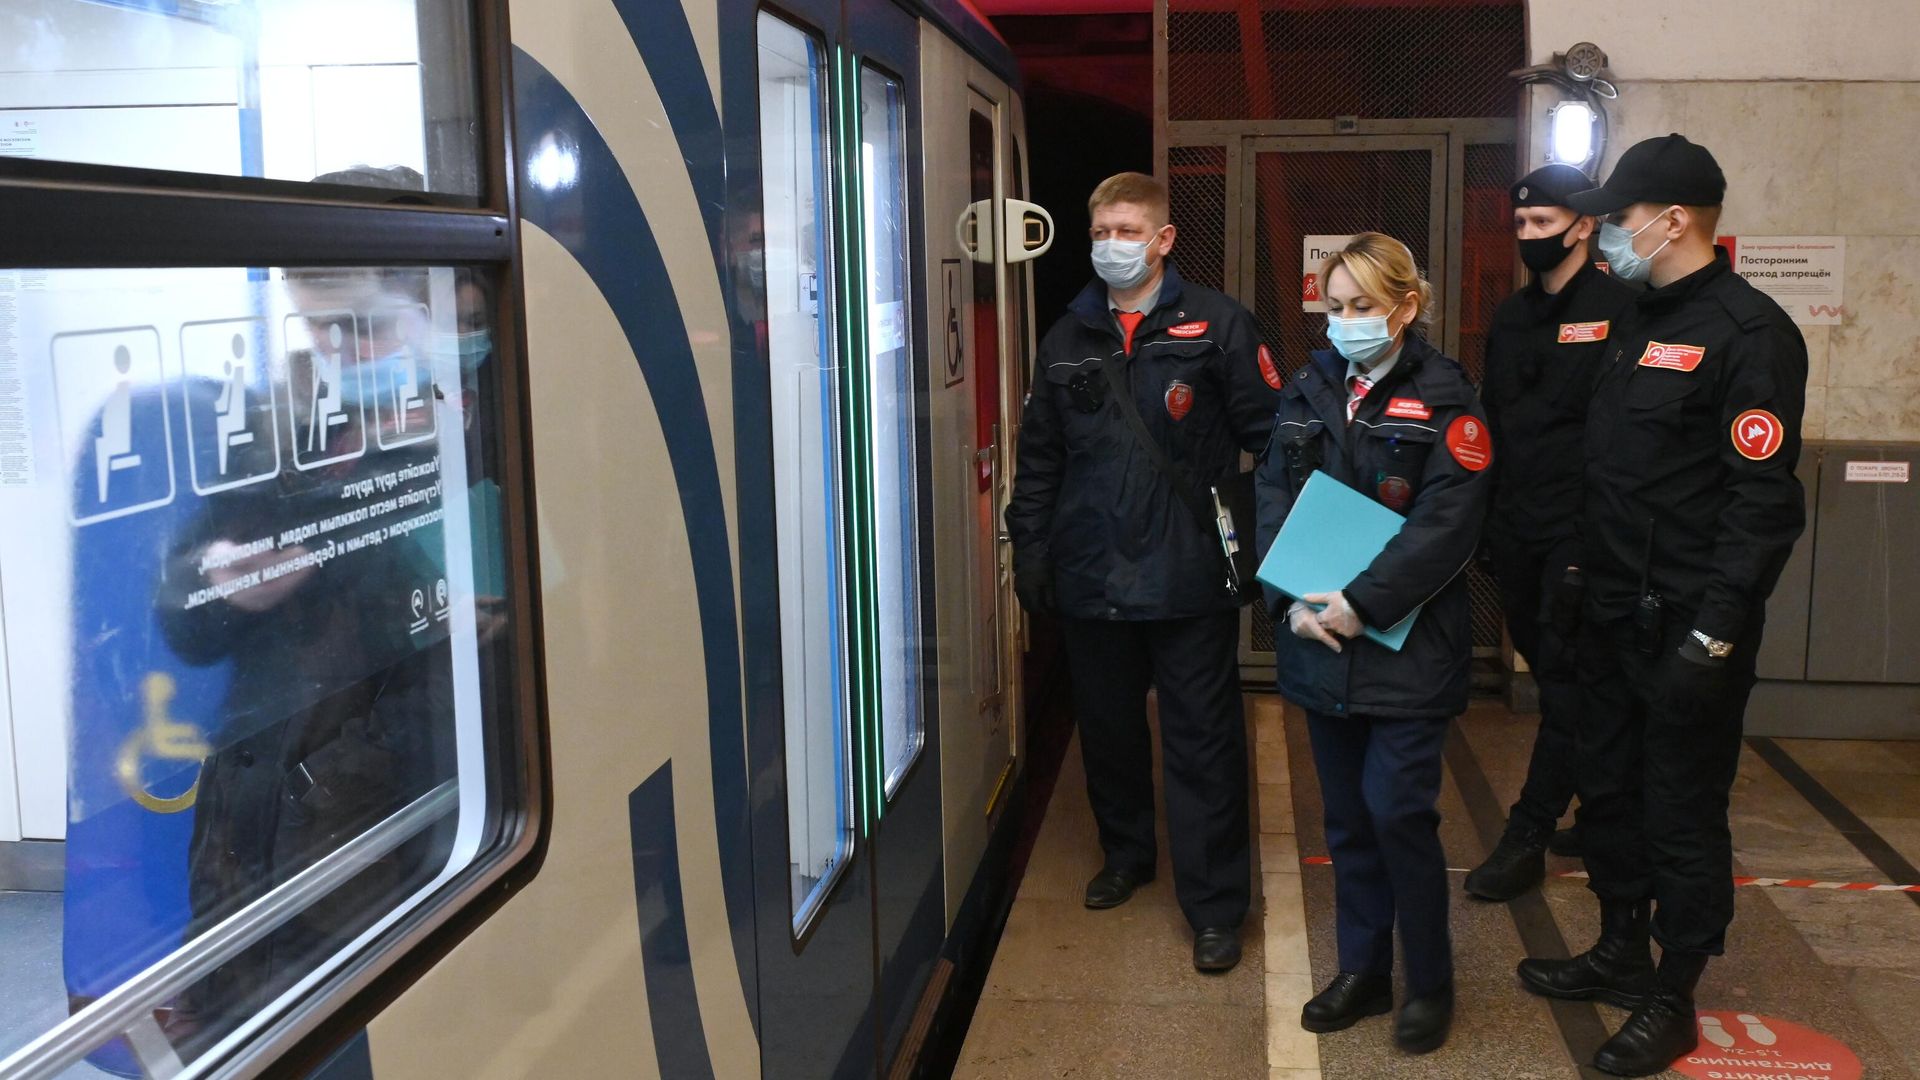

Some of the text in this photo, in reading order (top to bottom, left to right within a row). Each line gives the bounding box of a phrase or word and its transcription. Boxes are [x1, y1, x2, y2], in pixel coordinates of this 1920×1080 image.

[1740, 256, 1808, 266] Посторонним
[1780, 269, 1831, 279] запрещён
[1687, 1057, 1832, 1071] дистанцию
